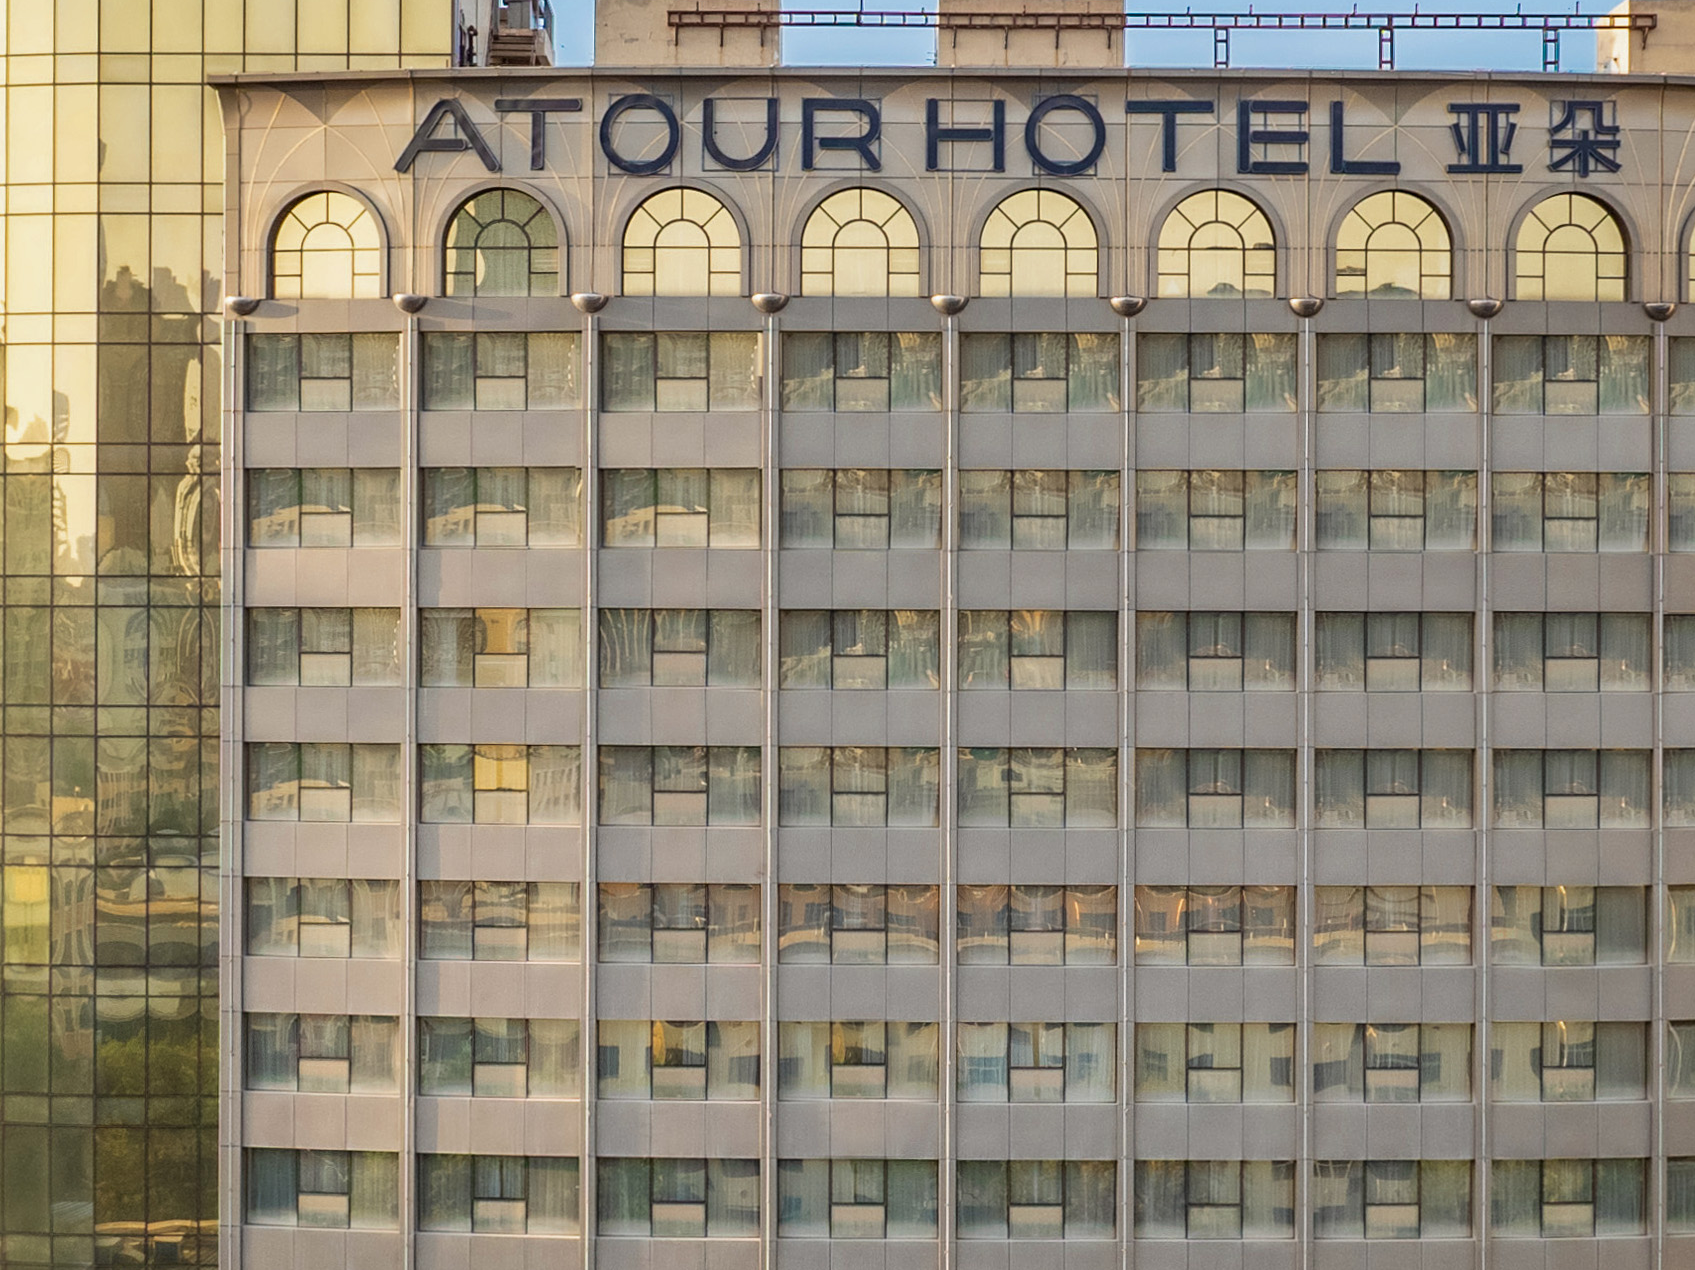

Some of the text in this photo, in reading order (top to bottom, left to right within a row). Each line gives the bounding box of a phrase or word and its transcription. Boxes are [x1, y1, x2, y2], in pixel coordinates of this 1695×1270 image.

[394, 93, 1623, 178] ATOUR HOTEL 亚朵
